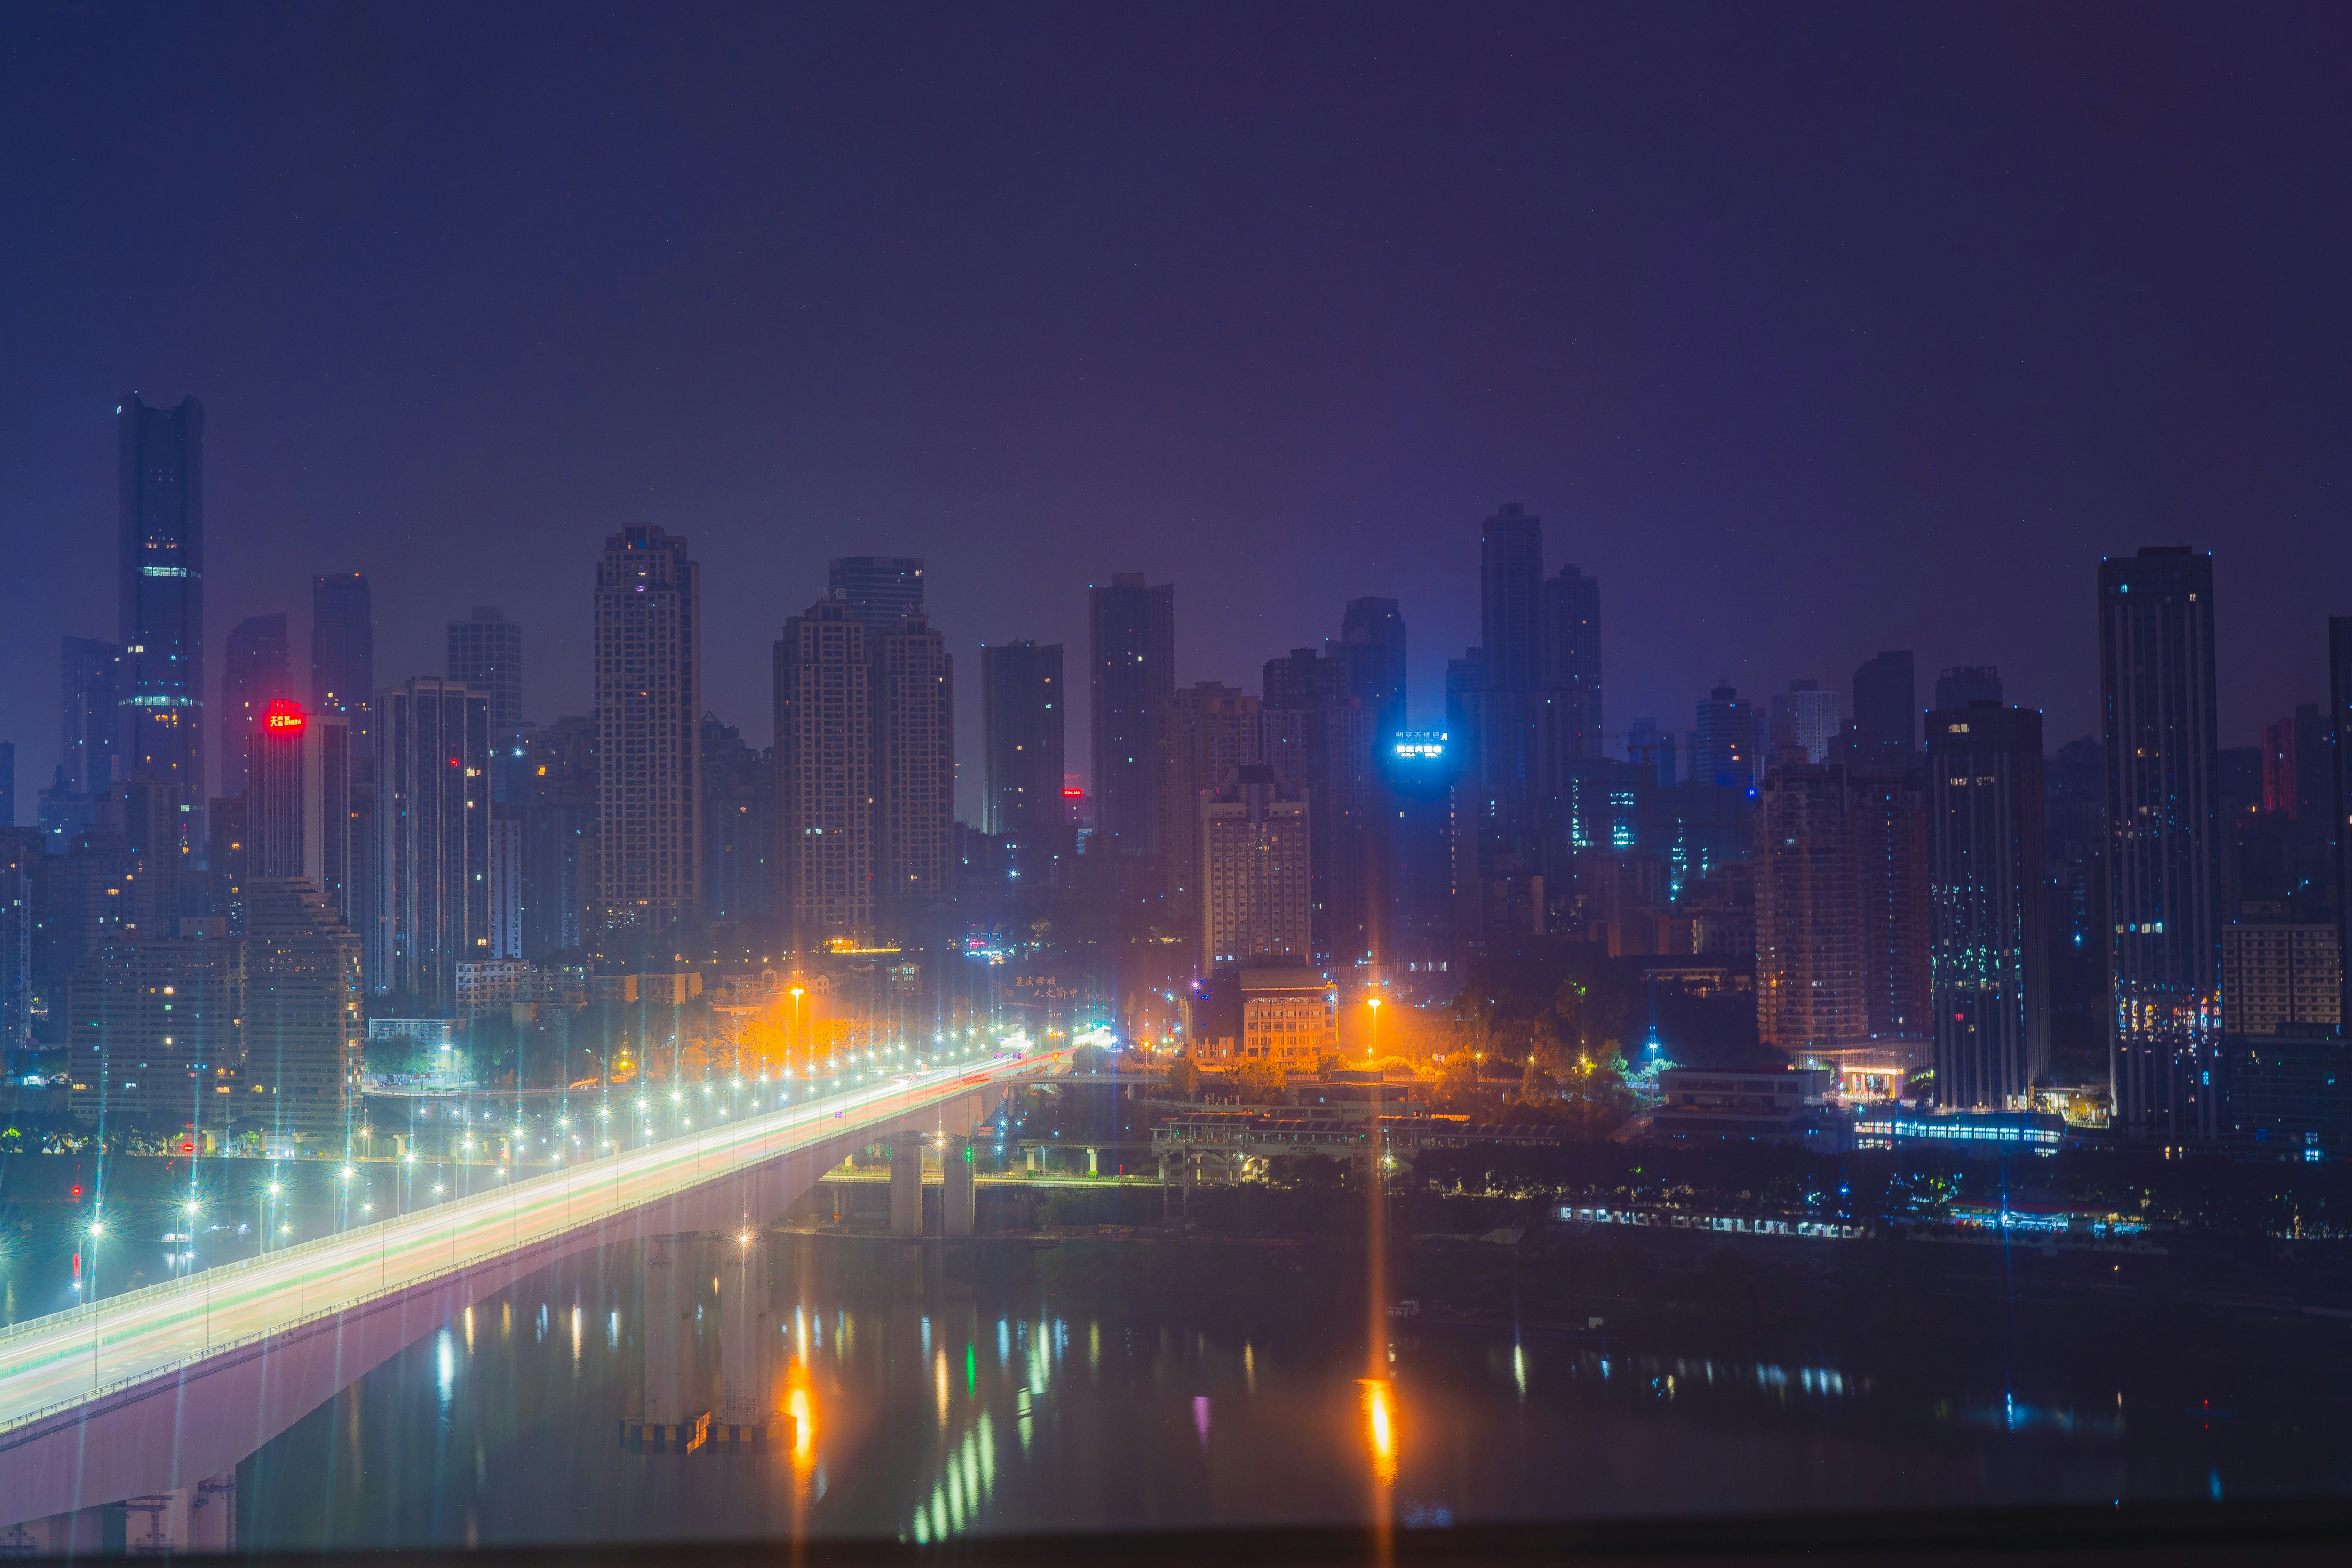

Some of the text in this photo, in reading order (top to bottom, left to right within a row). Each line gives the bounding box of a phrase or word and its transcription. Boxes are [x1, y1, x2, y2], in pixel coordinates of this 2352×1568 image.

[817, 587, 847, 602] 协信
[1015, 975, 1057, 987] 重庆母城
[1033, 987, 1078, 1000] 人文渝中
